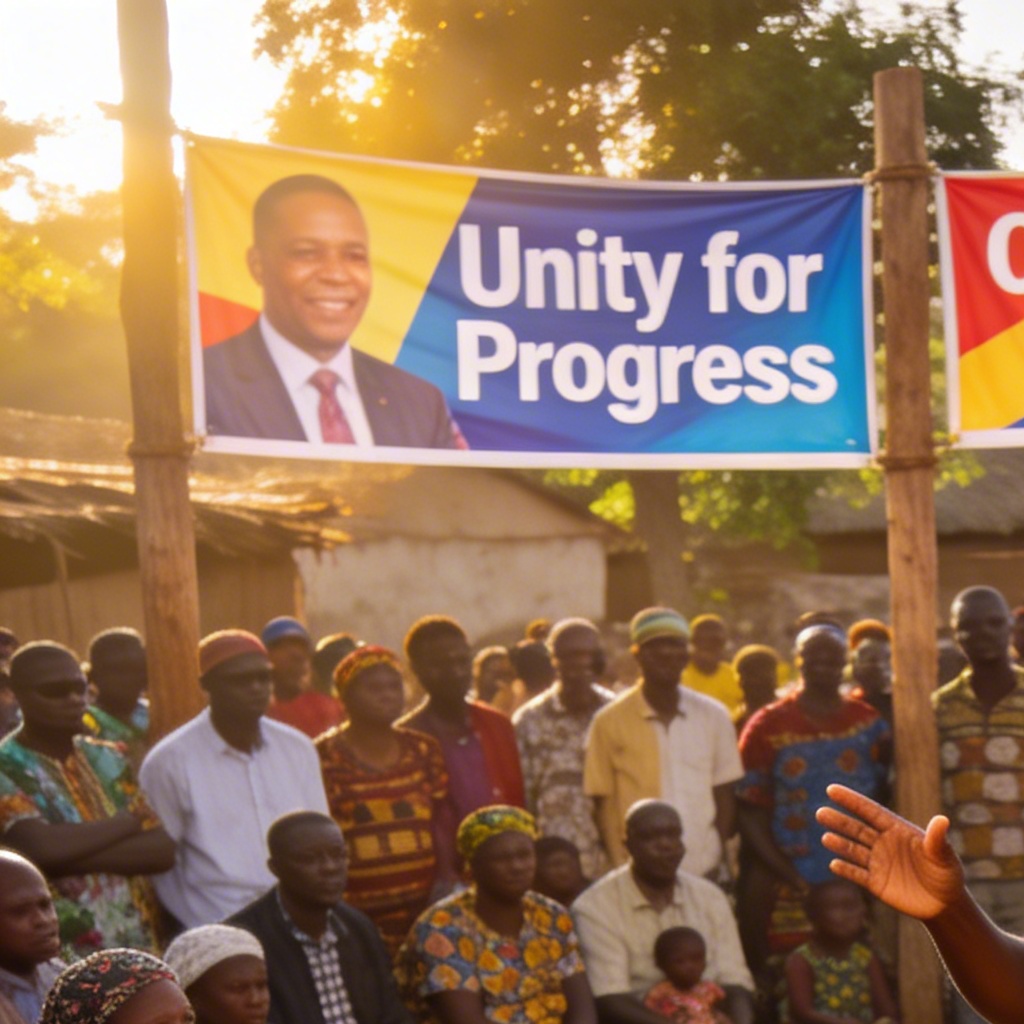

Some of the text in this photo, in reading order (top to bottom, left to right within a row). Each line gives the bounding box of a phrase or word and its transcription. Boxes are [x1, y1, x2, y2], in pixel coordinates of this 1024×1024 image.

[458, 223, 823, 333] Unity for
[456, 320, 838, 425] Progress
